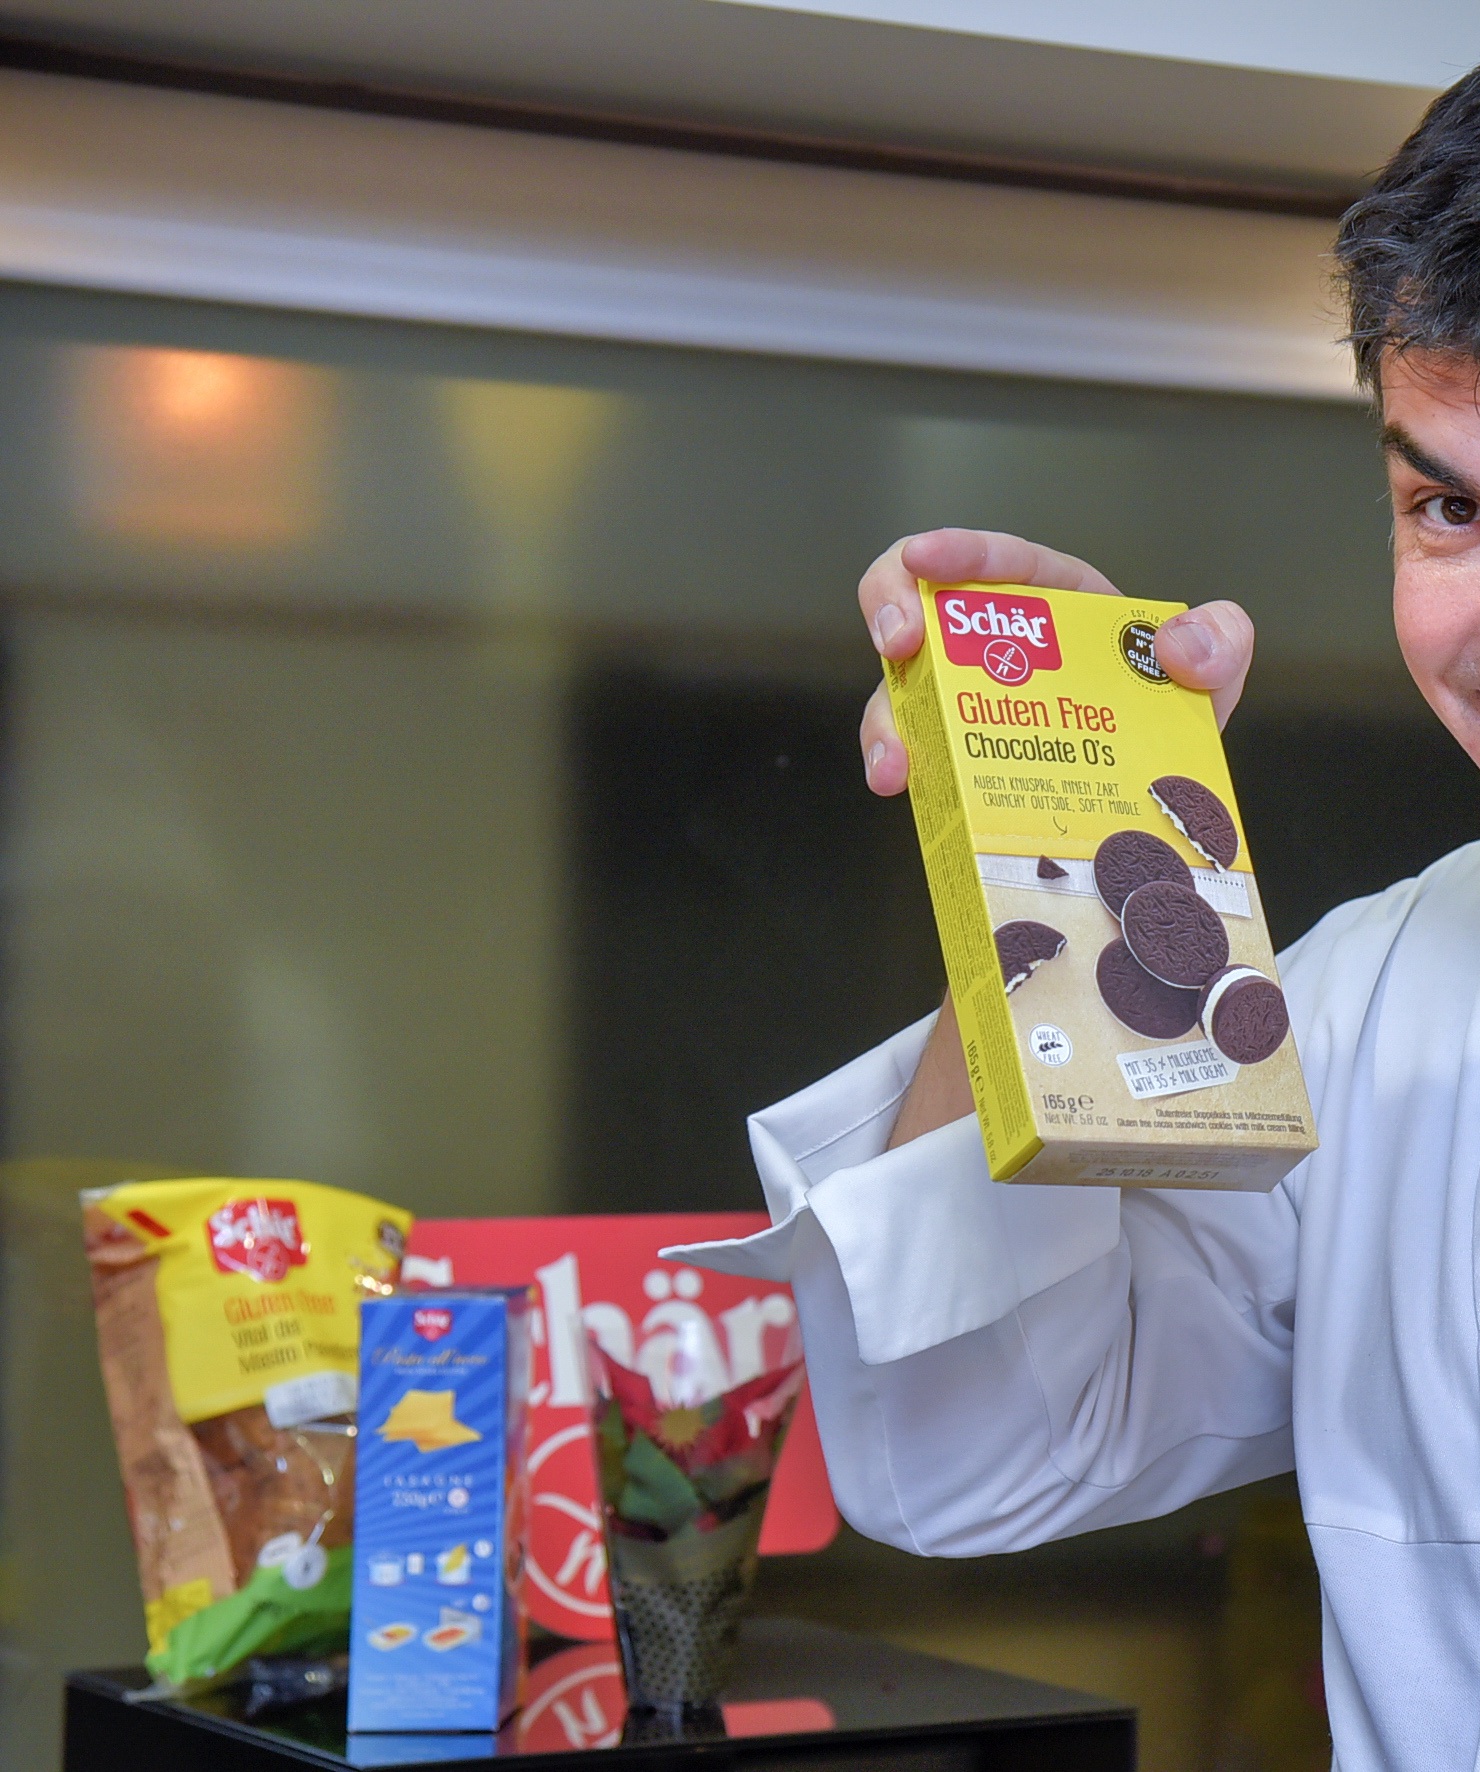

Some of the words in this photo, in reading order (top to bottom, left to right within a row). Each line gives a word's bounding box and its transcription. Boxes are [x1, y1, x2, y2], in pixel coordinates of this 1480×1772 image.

[944, 599, 1049, 648] Schär
[1137, 662, 1160, 678] FREE
[956, 691, 1051, 728] Gluten
[1056, 696, 1117, 734] Free
[964, 731, 1077, 764] Chocolate
[1082, 738, 1116, 767] O's
[1009, 776, 1059, 795] KNUSPRIG,
[1061, 779, 1092, 796] INNEN
[1096, 781, 1119, 798] ZART
[982, 791, 1027, 808] CRUNCHY
[1031, 794, 1075, 813] OUTSIDE,
[1078, 797, 1104, 814] SOFT
[1108, 799, 1141, 817] MIDDLE
[1036, 1030, 1060, 1041] WHEAT
[1043, 1053, 1062, 1064] FREE
[1124, 1060, 1142, 1076] MIT
[1143, 1057, 1157, 1073] 35
[1167, 1047, 1218, 1068] MILCHCREME
[1131, 1076, 1155, 1093] WITH
[1154, 1073, 1168, 1089] 35
[1178, 1068, 1199, 1084] MILK
[1199, 1062, 1229, 1081] CREAM
[1044, 1112, 1061, 1125] Net
[1117, 1118, 1138, 1127] Gluten
[1139, 1119, 1151, 1128] free
[1175, 1121, 1206, 1129] sandwich
[1208, 1122, 1233, 1130] cookies
[1235, 1123, 1250, 1131] with
[1251, 1123, 1266, 1131] milk
